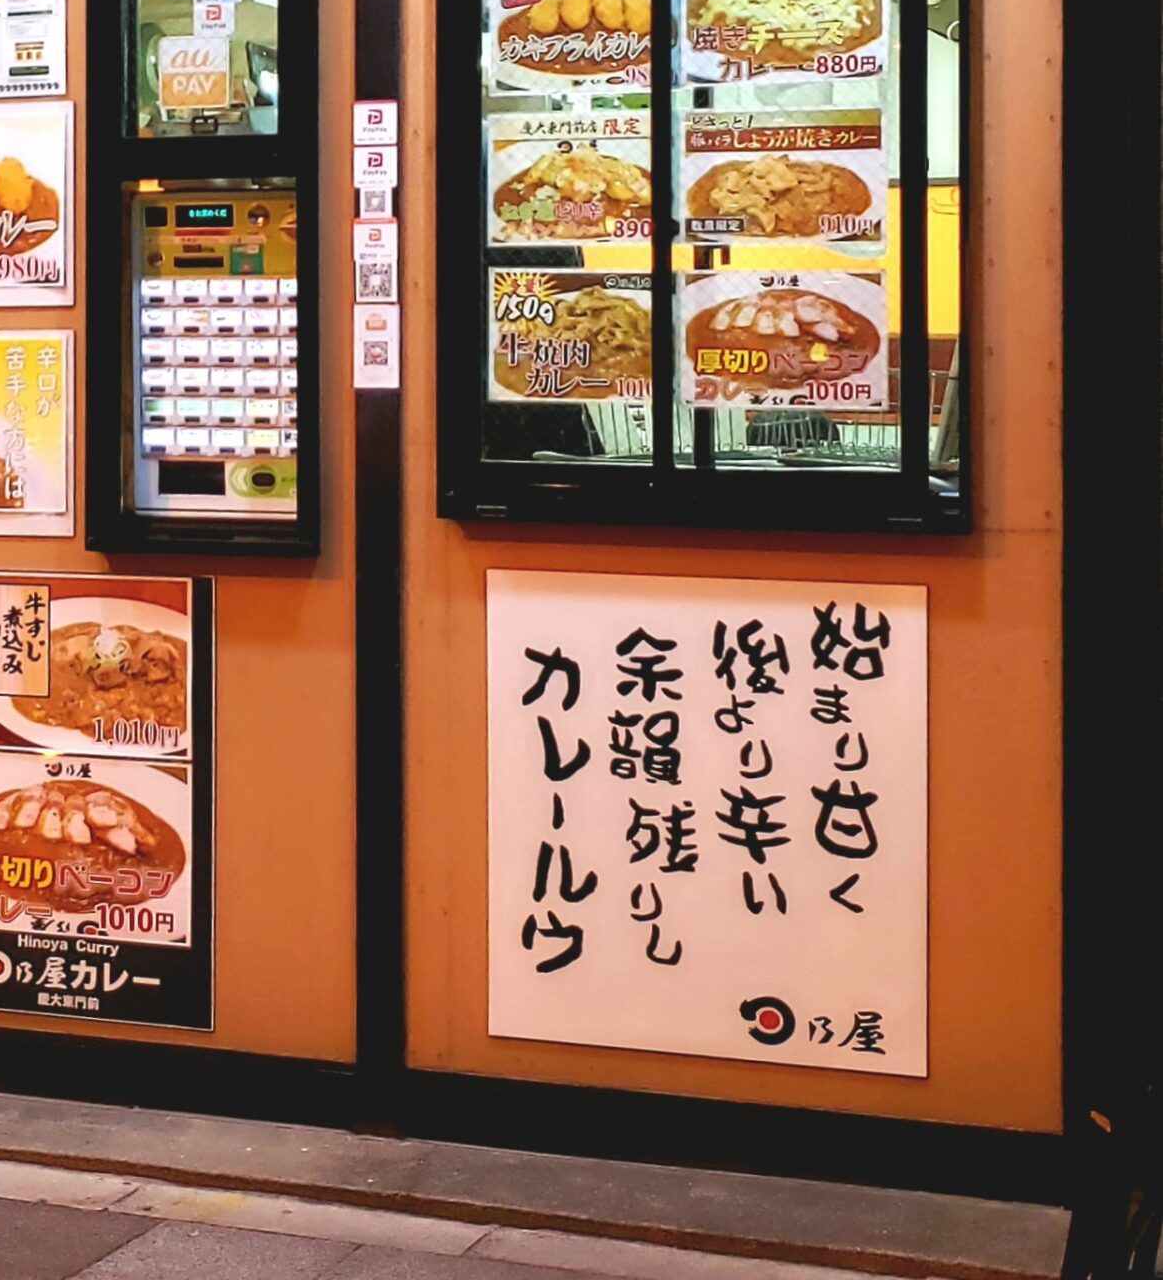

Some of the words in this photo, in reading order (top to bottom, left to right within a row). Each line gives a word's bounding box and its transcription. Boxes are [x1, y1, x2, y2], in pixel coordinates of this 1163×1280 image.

[170, 48, 217, 69] au
[815, 56, 878, 74] 880円
[172, 75, 216, 97] PAY
[37, 346, 60, 417] 辛口が
[525, 368, 609, 397] カレー
[805, 381, 871, 401] 1010円
[3, 346, 27, 499] 苦手な方には
[2, 606, 24, 675] 煮込み
[25, 592, 46, 662] 牛すじ
[93, 716, 180, 748] 1,010円
[712, 619, 793, 916] 後より辛い
[810, 600, 891, 915] 始まり甘く
[521, 647, 598, 974] カレールウ
[607, 627, 699, 966] 余韻残りし
[96, 903, 174, 933] 1010円
[17, 934, 68, 951] Hinoya
[76, 938, 119, 957] Curry
